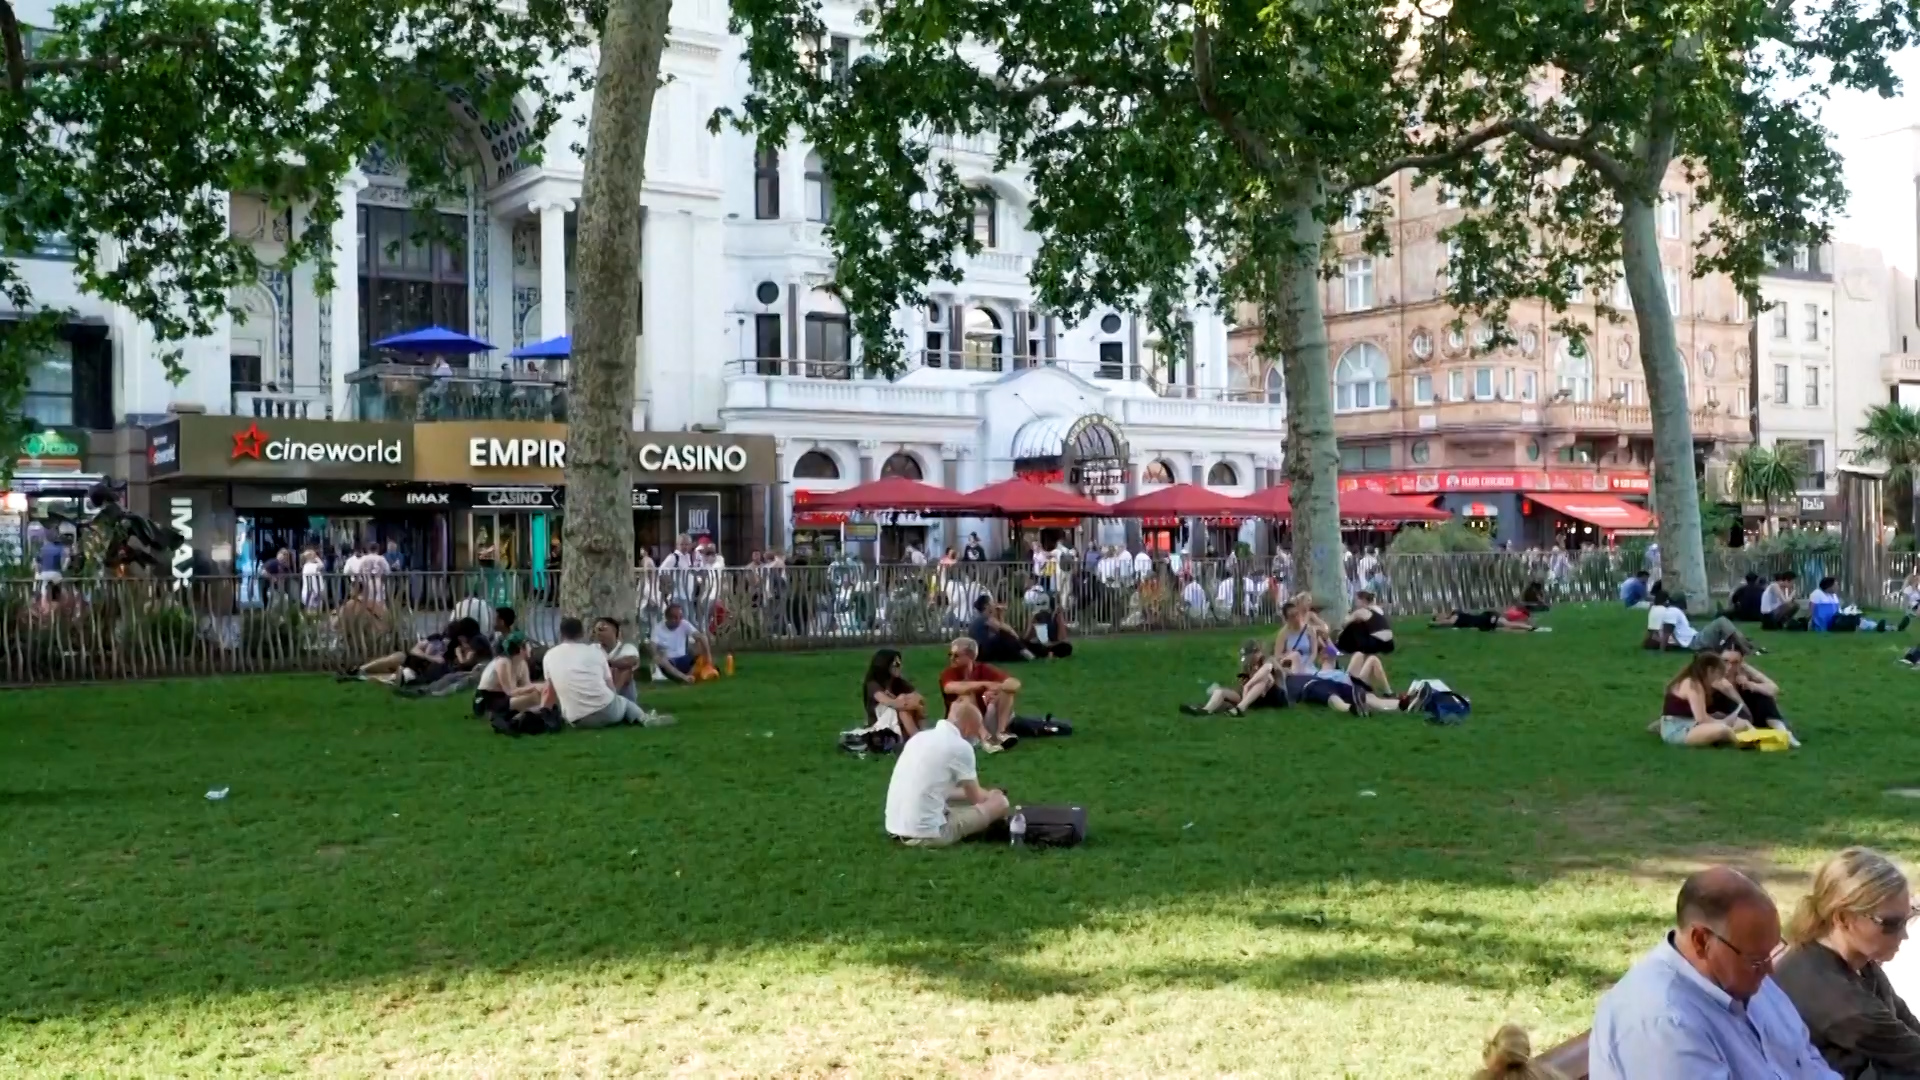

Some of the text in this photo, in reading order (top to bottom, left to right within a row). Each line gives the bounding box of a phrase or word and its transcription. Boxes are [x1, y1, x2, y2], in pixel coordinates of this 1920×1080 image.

[265, 437, 402, 464] cineworld
[469, 437, 747, 473] EMPIR CASINO
[340, 489, 376, 506] 4DX
[406, 493, 450, 504] IMAX
[487, 492, 543, 505] CASINO
[170, 497, 194, 593] IMAX
